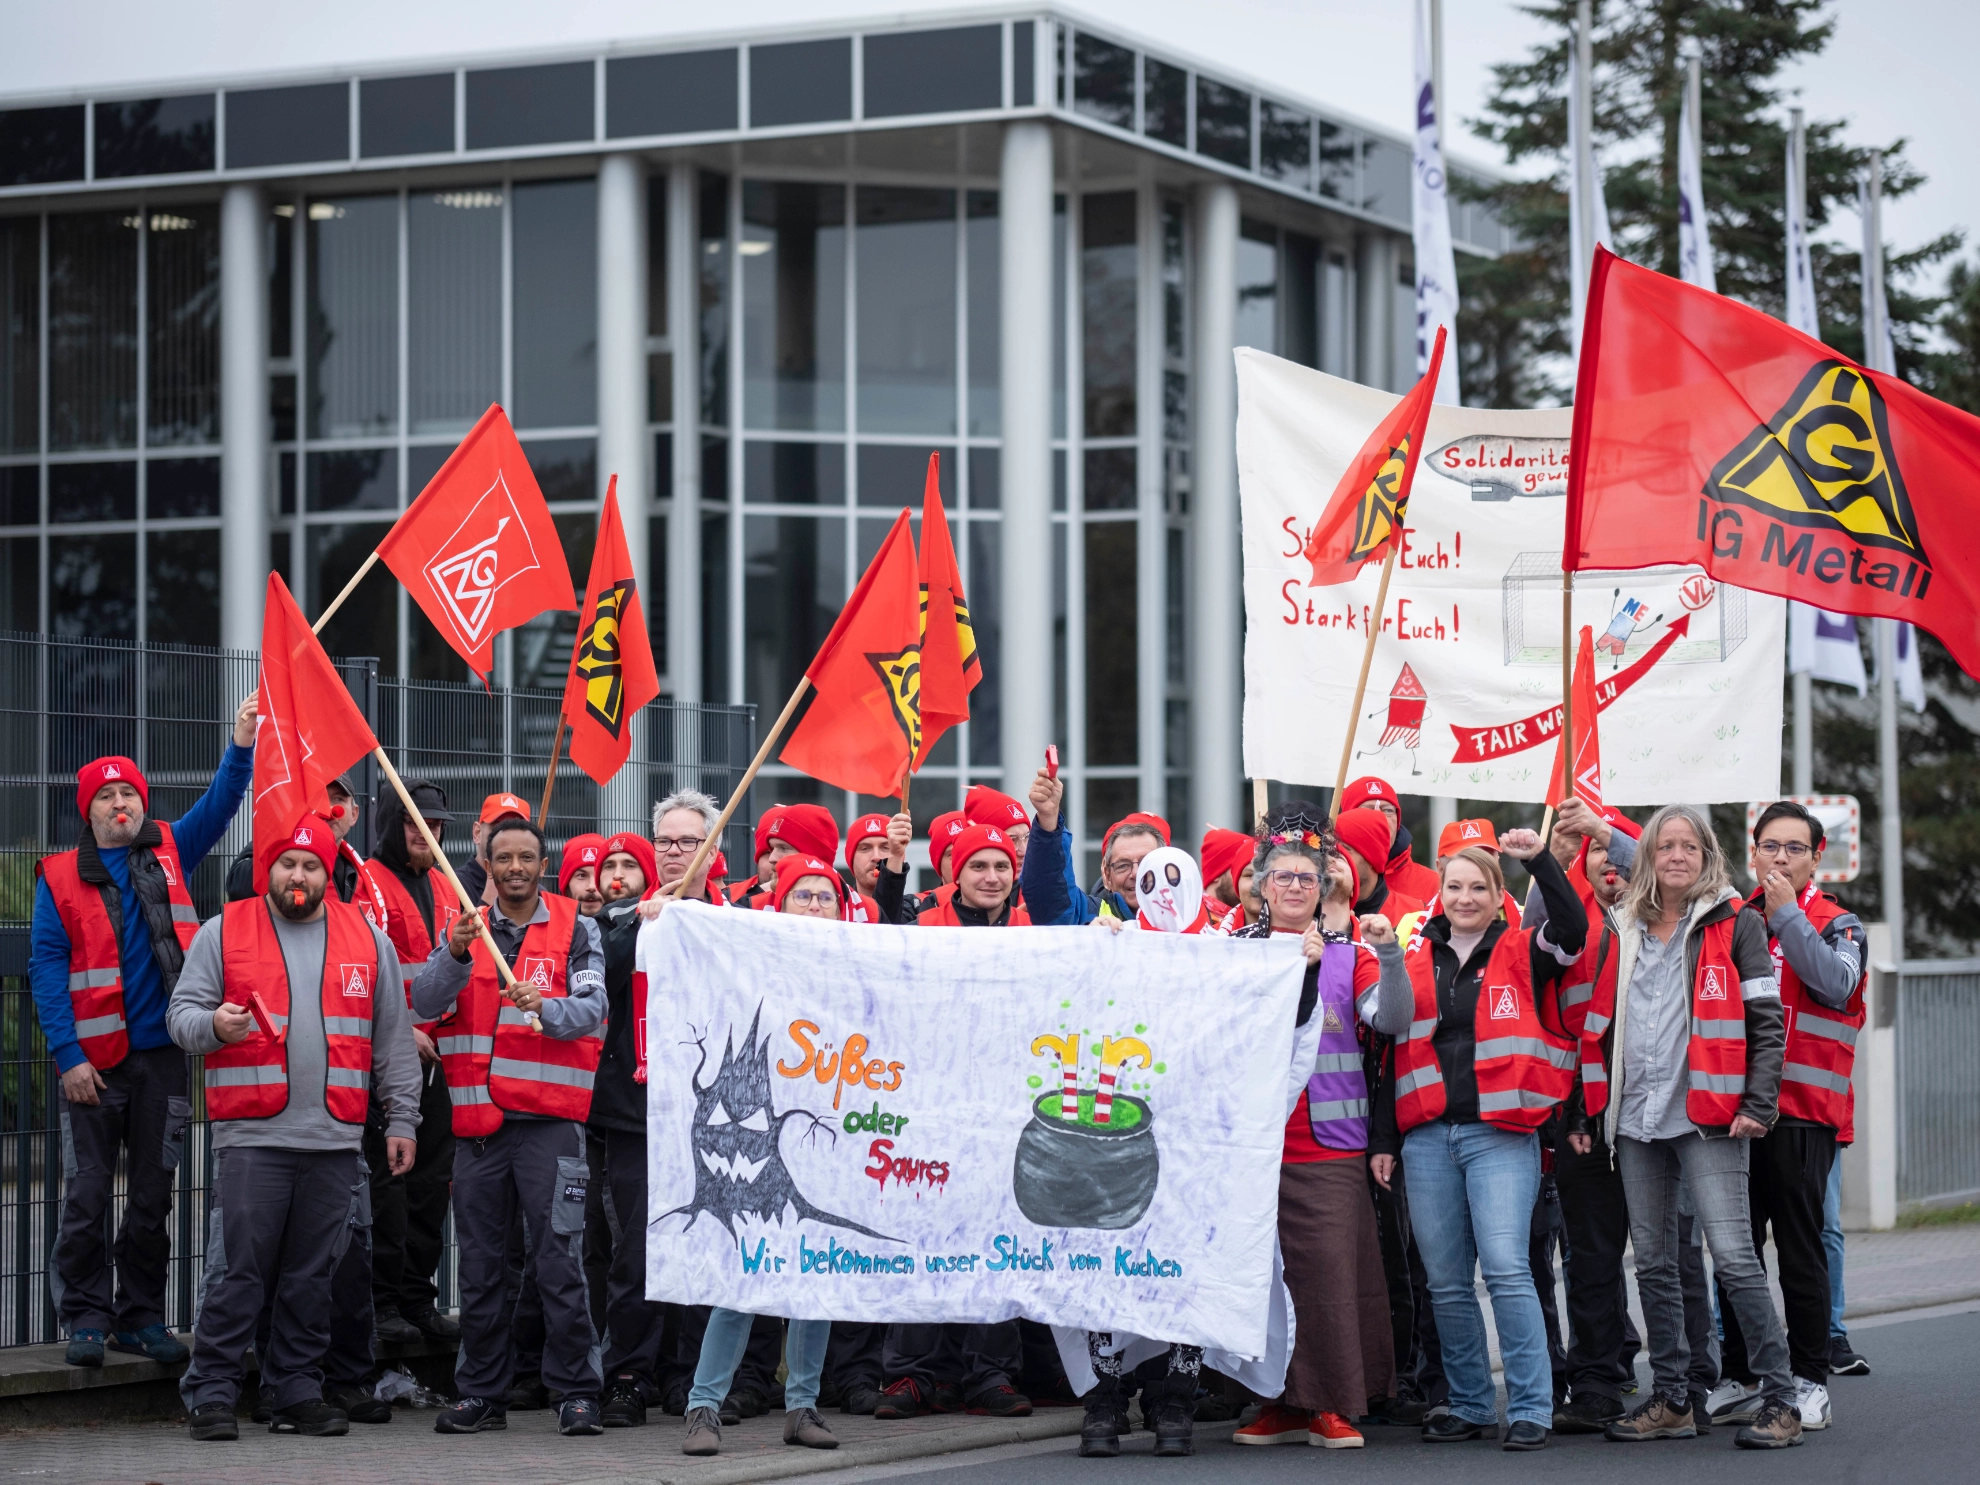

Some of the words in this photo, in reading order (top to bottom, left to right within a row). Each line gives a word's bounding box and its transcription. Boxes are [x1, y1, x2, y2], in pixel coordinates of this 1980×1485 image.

[1444, 443, 1570, 468] Solidaritä
[1697, 498, 1743, 560] IG
[1760, 522, 1933, 600] Metall
[1282, 579, 1357, 630] Stark
[1363, 604, 1392, 639] fr
[1397, 598, 1460, 642] Euch!
[1622, 597, 1649, 623] ME
[1682, 577, 1713, 607] VL
[1470, 722, 1529, 756] FAIR
[776, 1019, 906, 1110] Süßes
[843, 1101, 909, 1136] oder
[865, 1139, 950, 1190] Saures
[741, 1235, 786, 1274] Wir
[799, 1234, 915, 1274] bekommen
[926, 1253, 980, 1274] unser
[985, 1234, 1054, 1271] Stück
[1068, 1252, 1102, 1271] vom
[1114, 1246, 1182, 1277] Kuchen
